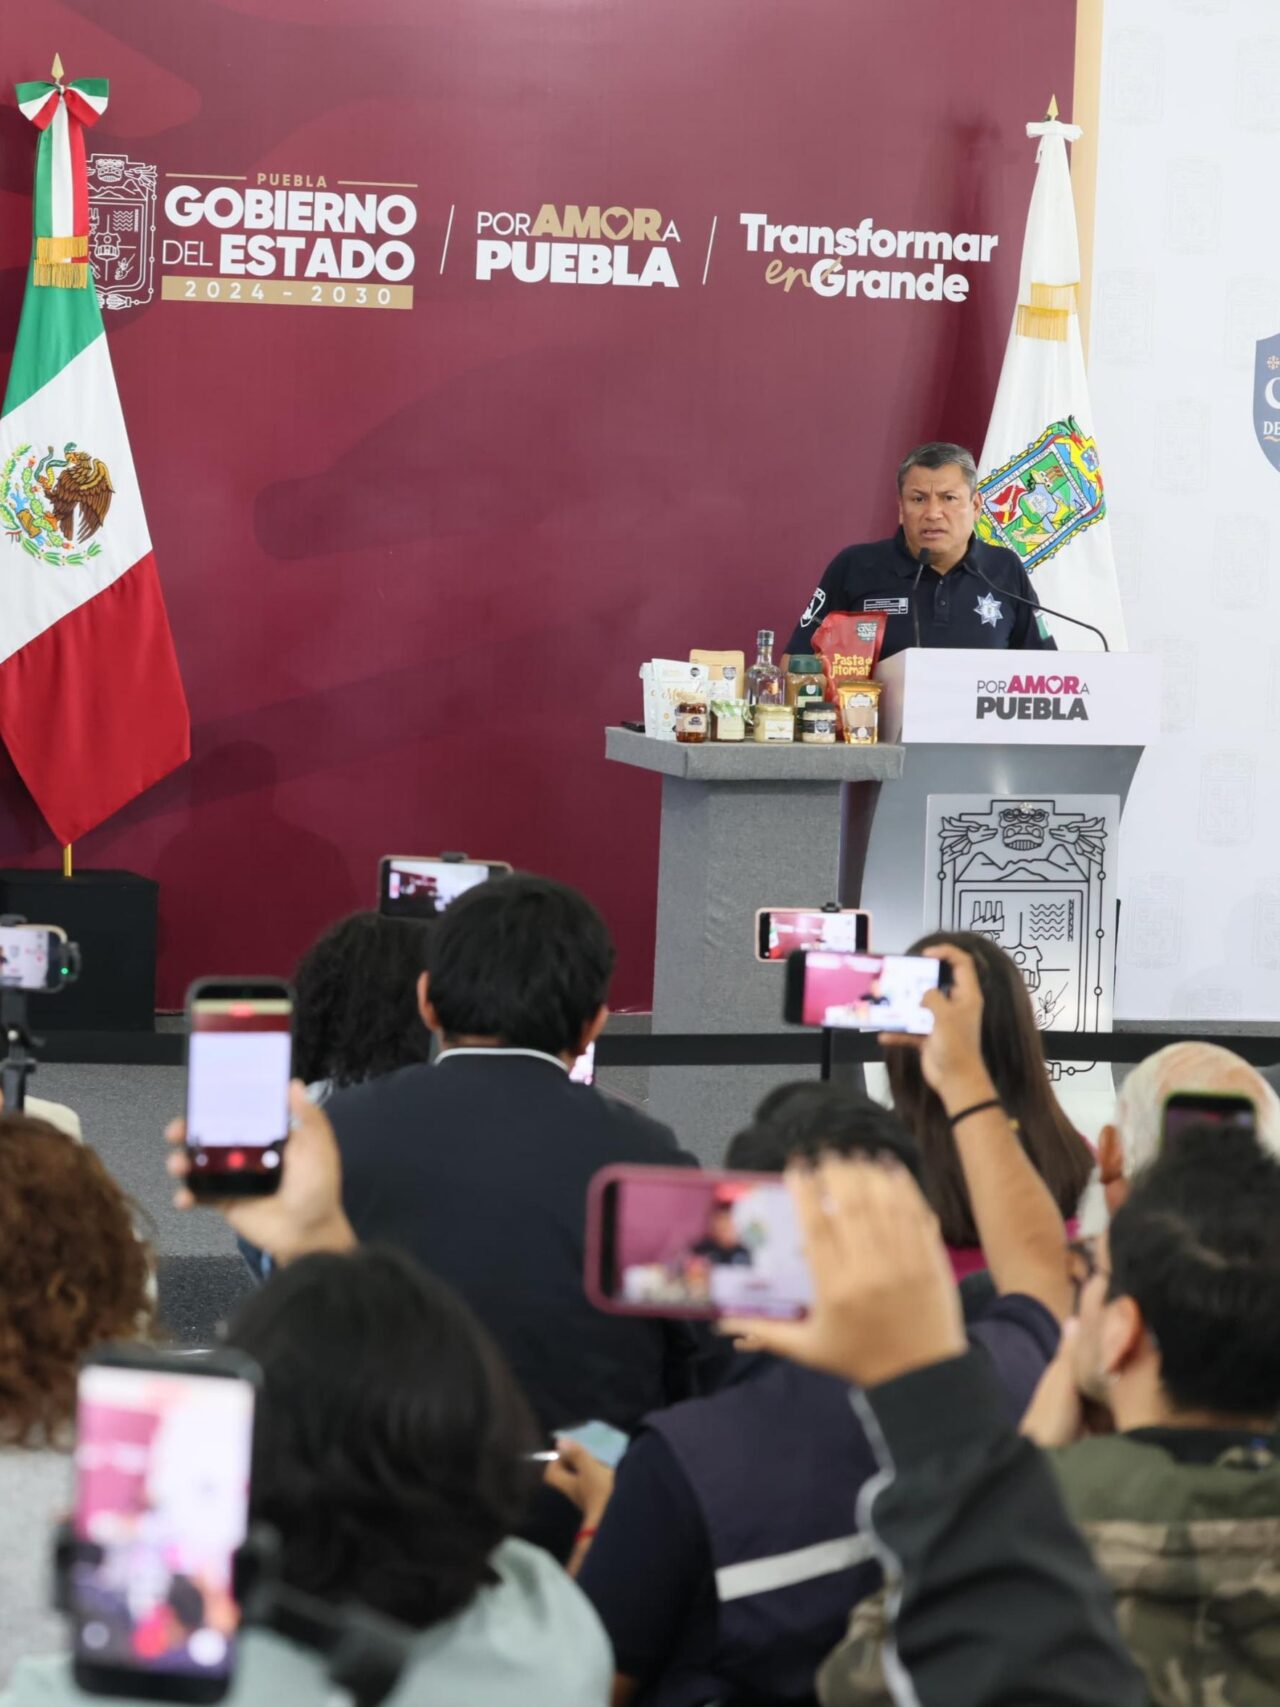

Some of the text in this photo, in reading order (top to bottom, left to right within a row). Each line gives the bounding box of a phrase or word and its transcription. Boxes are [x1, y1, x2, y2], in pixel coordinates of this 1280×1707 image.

[257, 173, 327, 188] PUEBLA
[164, 185, 417, 236] GOBIERNO
[162, 234, 415, 281] DEL ESTADO
[739, 213, 999, 262] Transformar
[475, 240, 680, 287] PUEBLA
[810, 258, 970, 302] Grande
[185, 281, 264, 300] 2024
[311, 285, 391, 305] 2030
[832, 653, 866, 666] Pasta
[976, 697, 1089, 720] PUEBLA
